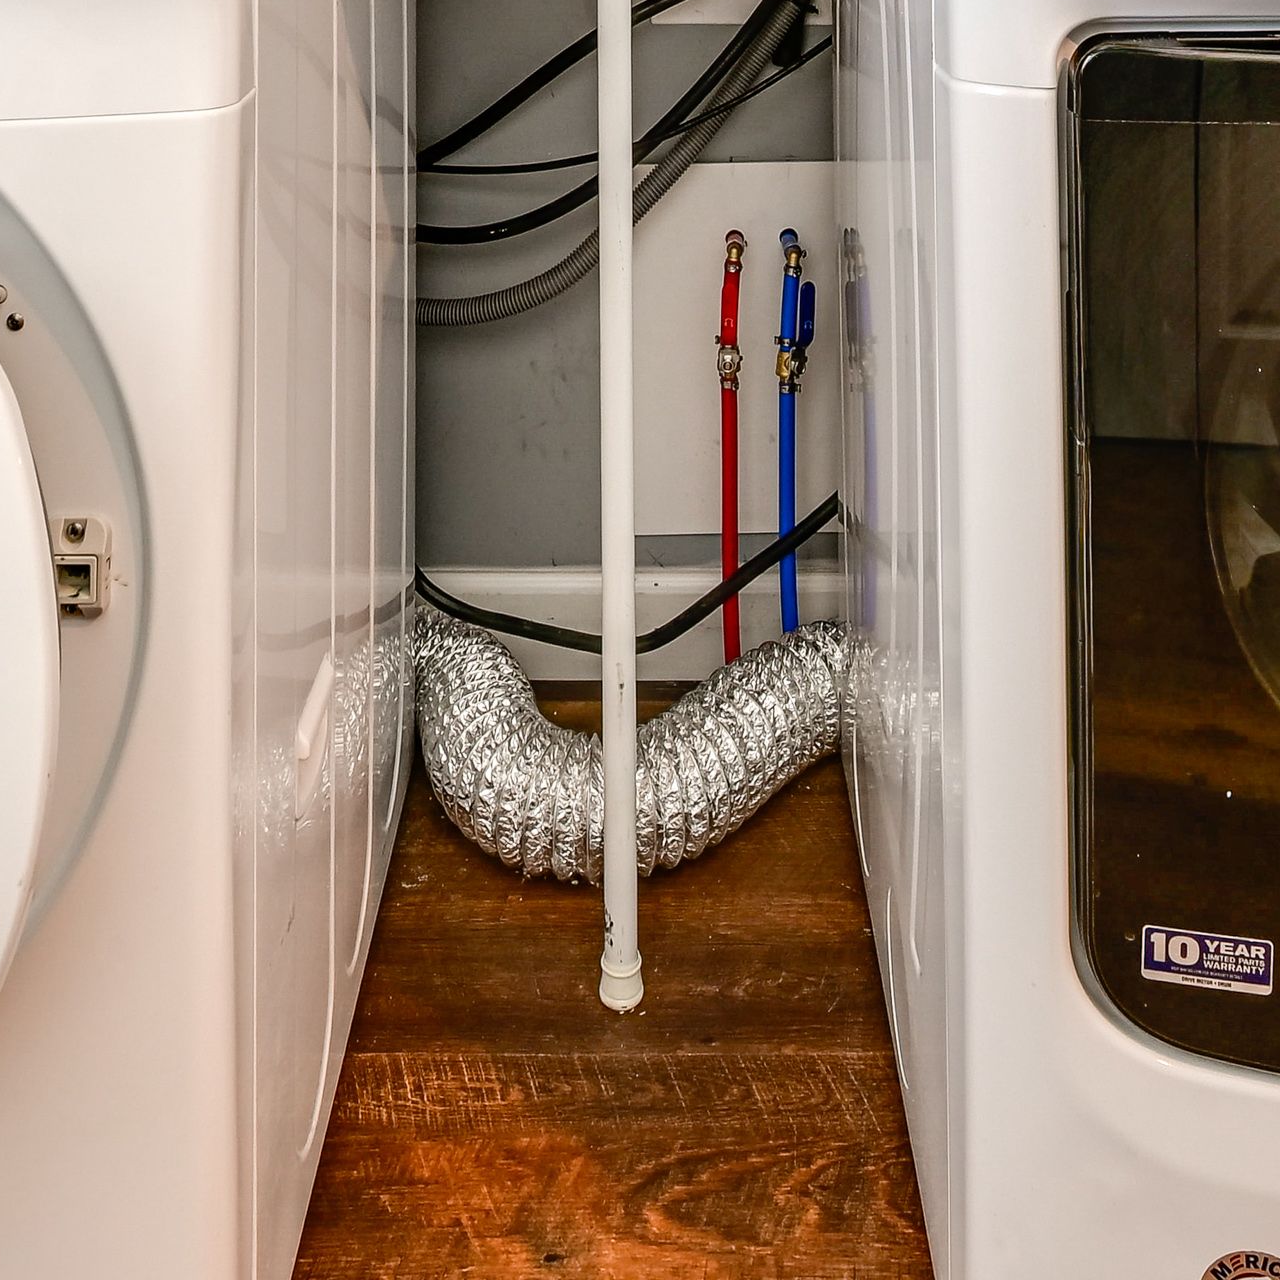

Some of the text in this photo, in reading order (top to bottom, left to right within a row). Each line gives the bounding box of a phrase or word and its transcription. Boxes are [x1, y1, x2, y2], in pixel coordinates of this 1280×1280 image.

[1150, 932, 1266, 966] 10 YEAR
[1202, 952, 1266, 967] LIMITED PARTS
[1202, 960, 1265, 976] WARRANTY
